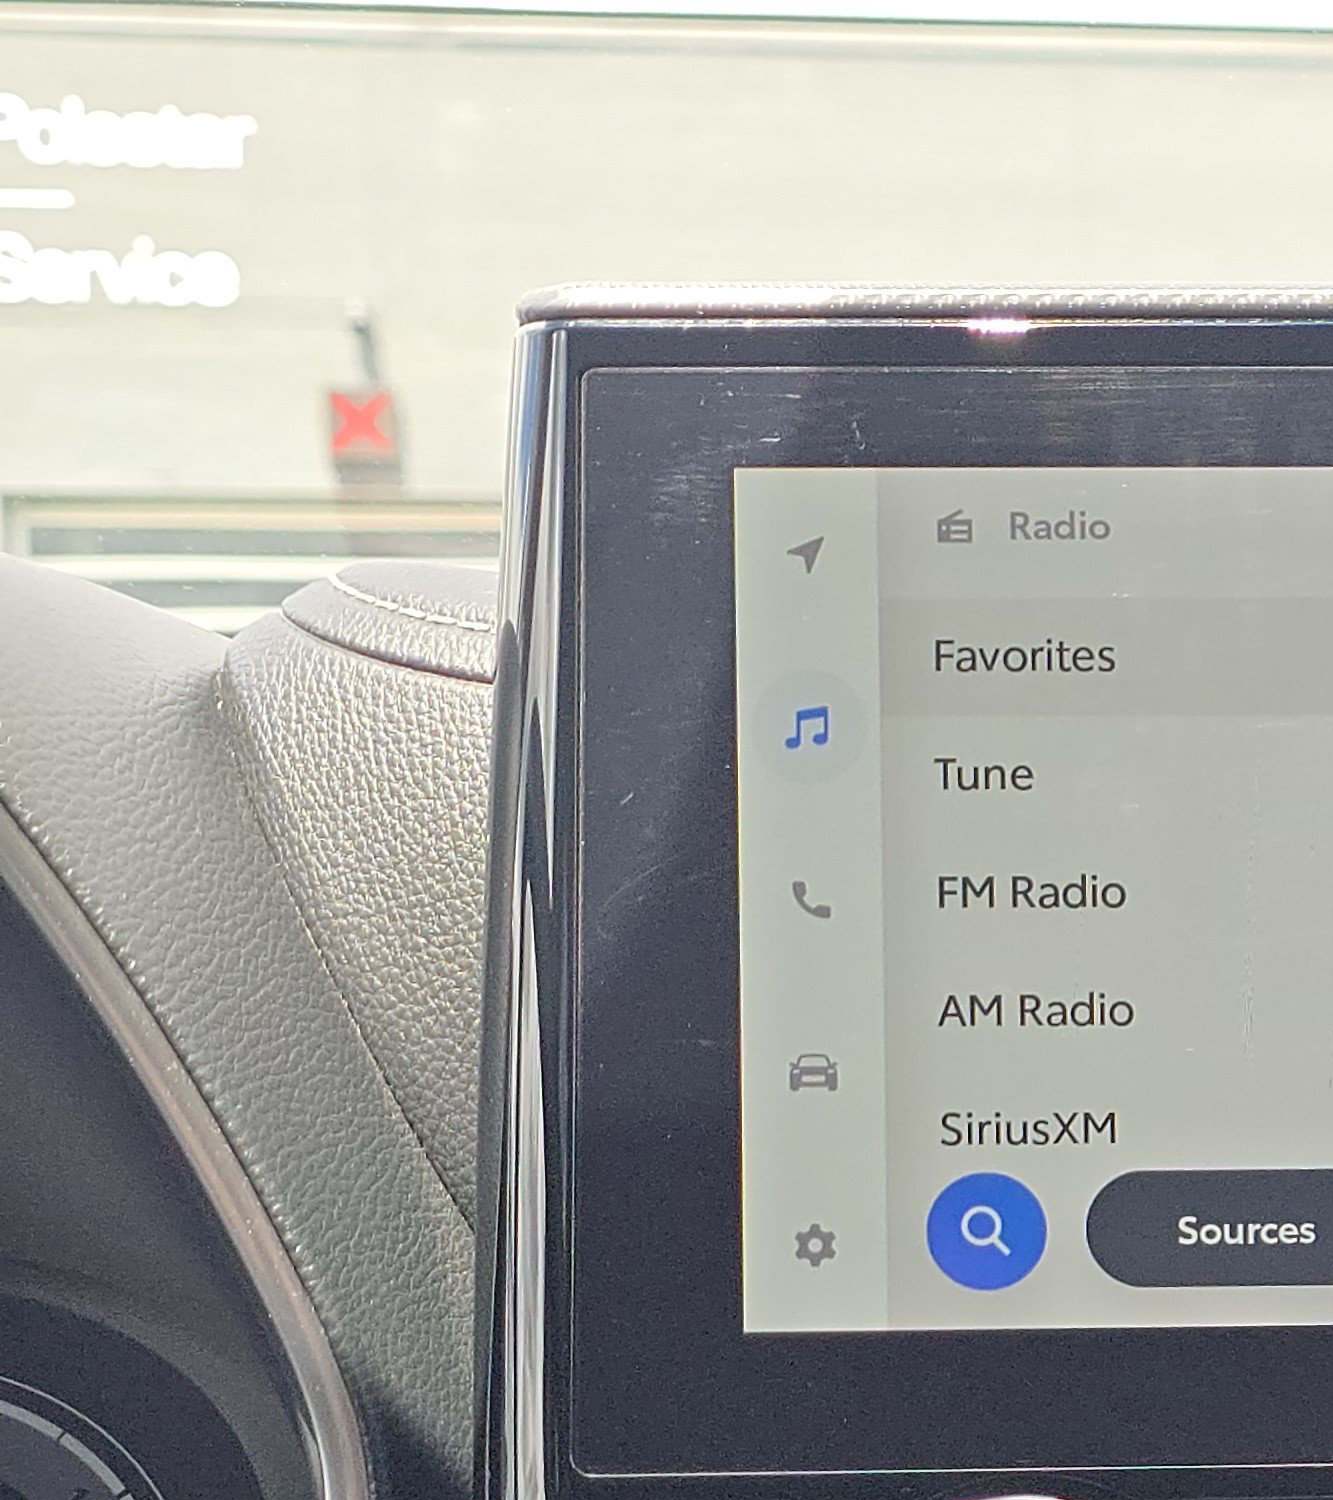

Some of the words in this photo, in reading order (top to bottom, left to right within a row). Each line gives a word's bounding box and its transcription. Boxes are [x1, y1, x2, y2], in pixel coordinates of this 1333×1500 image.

[0, 230, 241, 307] Service
[1010, 510, 1110, 540] Radio
[936, 639, 1115, 672] Favorites
[934, 758, 1033, 791] Tune
[939, 876, 995, 908] FM
[1012, 874, 1126, 909] Radio
[939, 995, 1002, 1026] AM
[1020, 992, 1133, 1026] Radio
[941, 1112, 1115, 1146] SiriusXM
[1178, 1216, 1316, 1245] Sources
